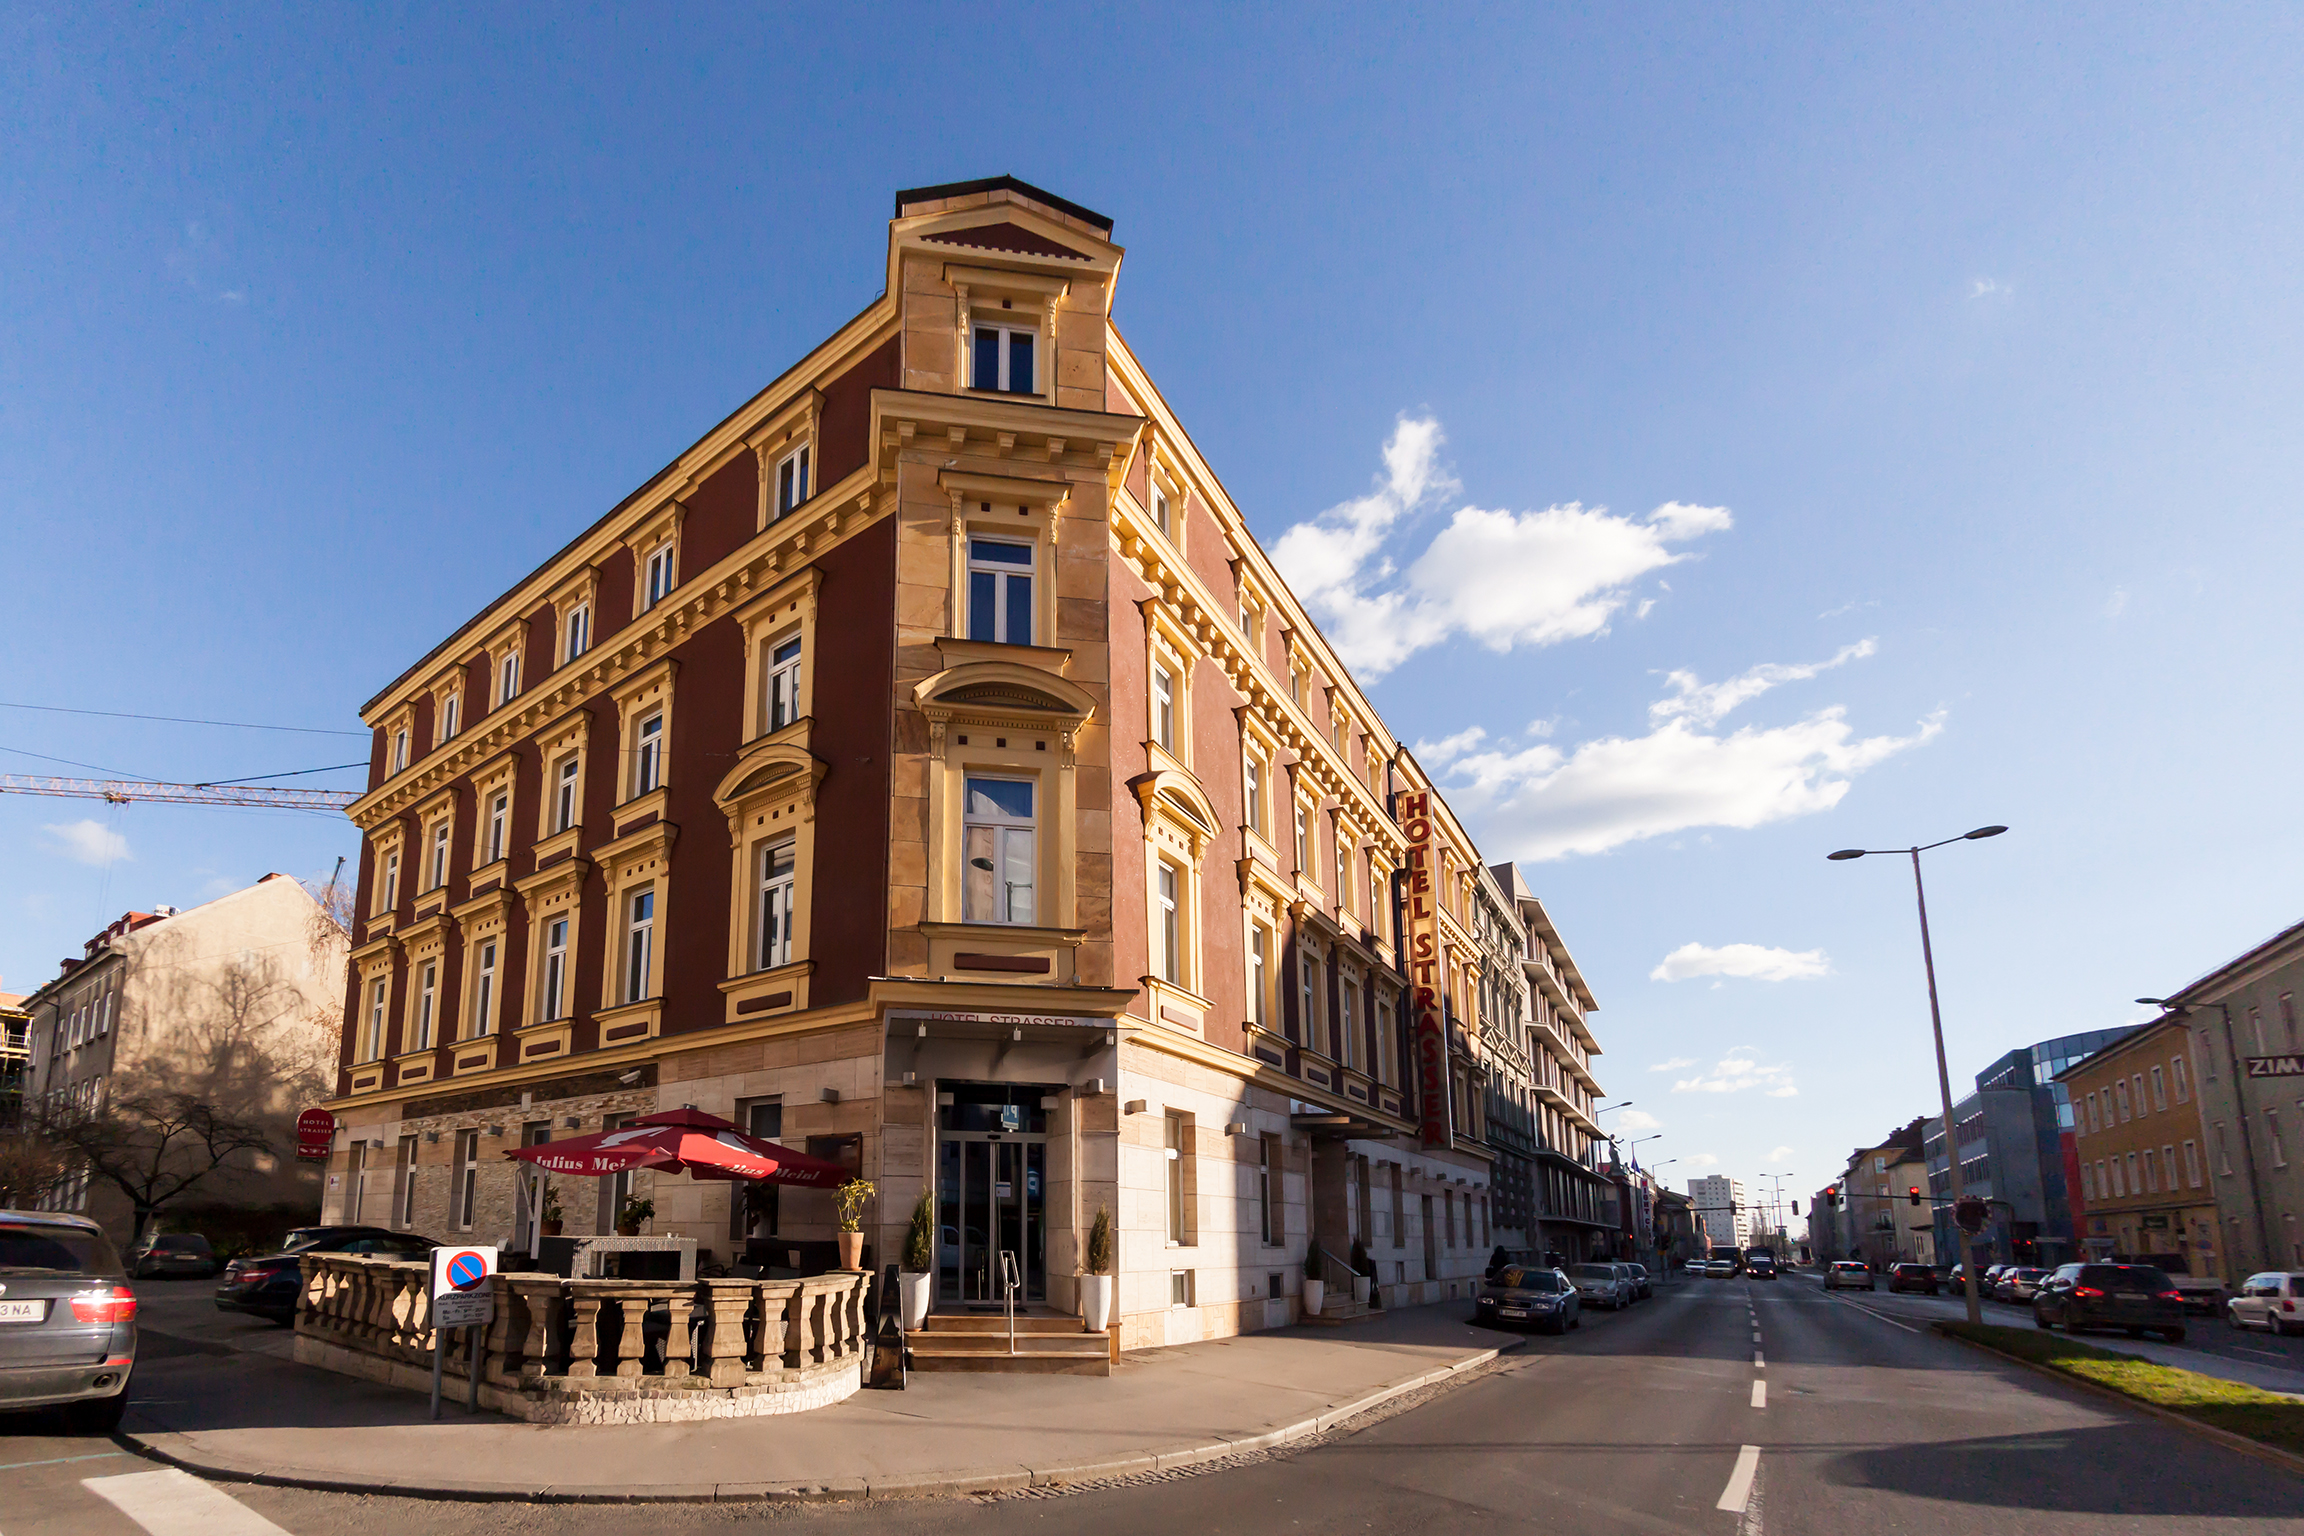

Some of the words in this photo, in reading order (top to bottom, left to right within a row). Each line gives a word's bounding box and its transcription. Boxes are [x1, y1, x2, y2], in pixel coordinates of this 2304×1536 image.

[1404, 793, 1432, 919] HOTEL
[1413, 933, 1445, 1145] STRASSER
[2249, 1058, 2304, 1074] ZIM
[591, 1158, 626, 1171] Mei
[772, 1167, 820, 1180] Meinl
[439, 1292, 491, 1300] KURZPARKZONE
[12, 1305, 32, 1316] NA
